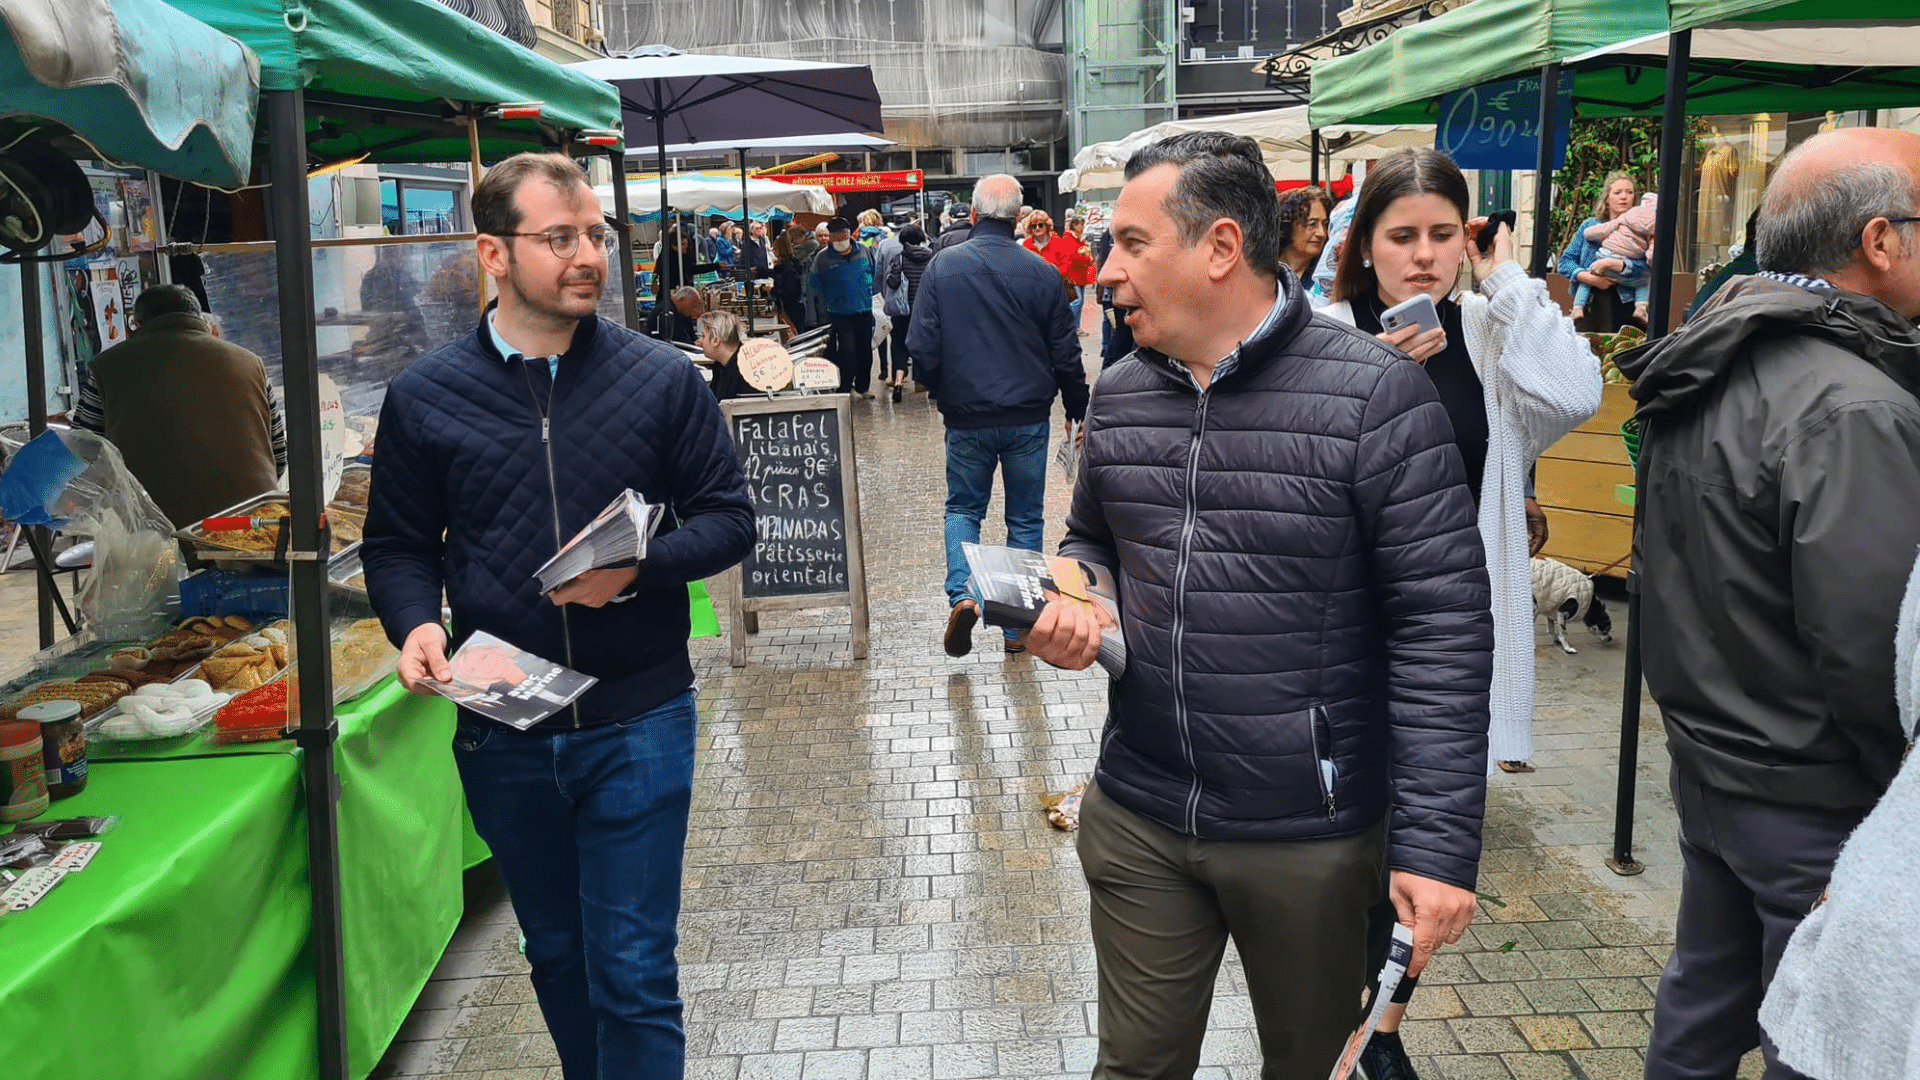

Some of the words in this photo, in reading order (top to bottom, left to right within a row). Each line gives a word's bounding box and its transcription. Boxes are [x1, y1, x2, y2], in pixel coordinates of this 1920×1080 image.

[835, 176, 854, 187] CHEZ
[739, 414, 830, 445] Falafel
[747, 482, 830, 509] ACRAS
[755, 515, 841, 540] MPANADAS
[755, 542, 843, 563] Pâtisserie
[752, 563, 844, 585] orientale
[507, 673, 540, 698] avec
[516, 667, 563, 700] Marine
